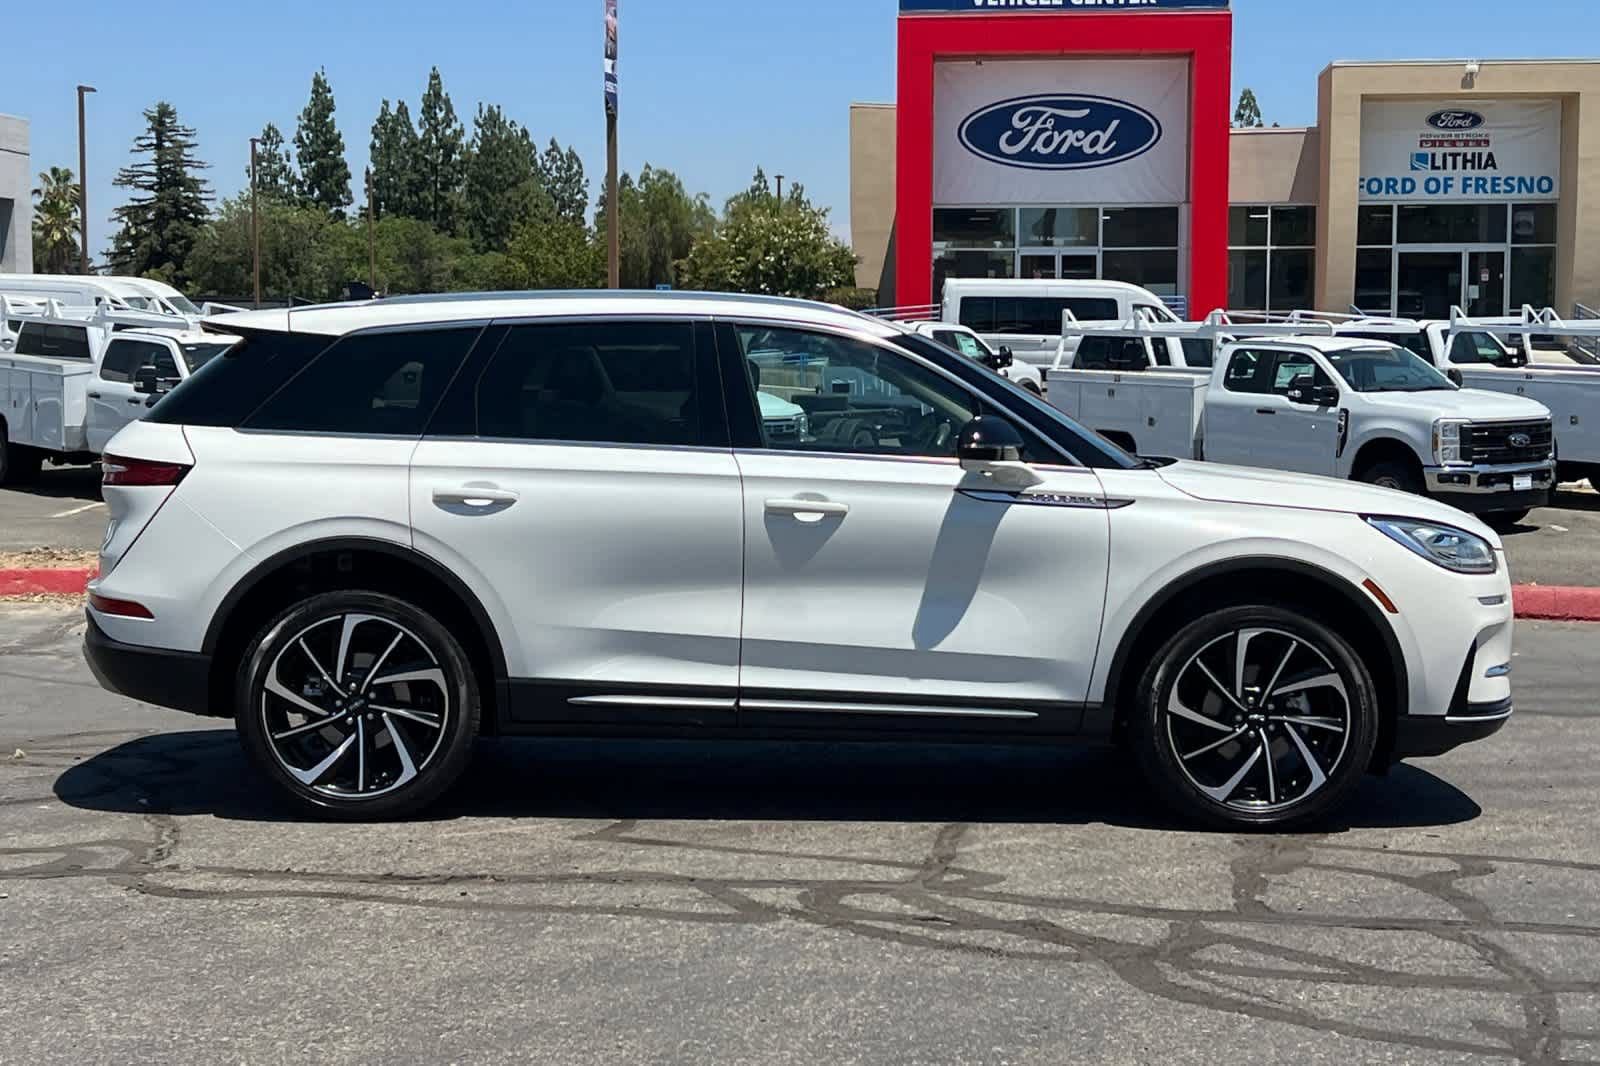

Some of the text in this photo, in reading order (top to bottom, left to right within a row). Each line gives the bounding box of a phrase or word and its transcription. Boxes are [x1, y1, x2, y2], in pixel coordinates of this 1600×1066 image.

[1437, 112, 1473, 127] Ford
[999, 105, 1121, 155] Ford
[1430, 152, 1498, 171] LITHIA
[1424, 176, 1454, 195] OF
[1462, 175, 1553, 195] FRESNO
